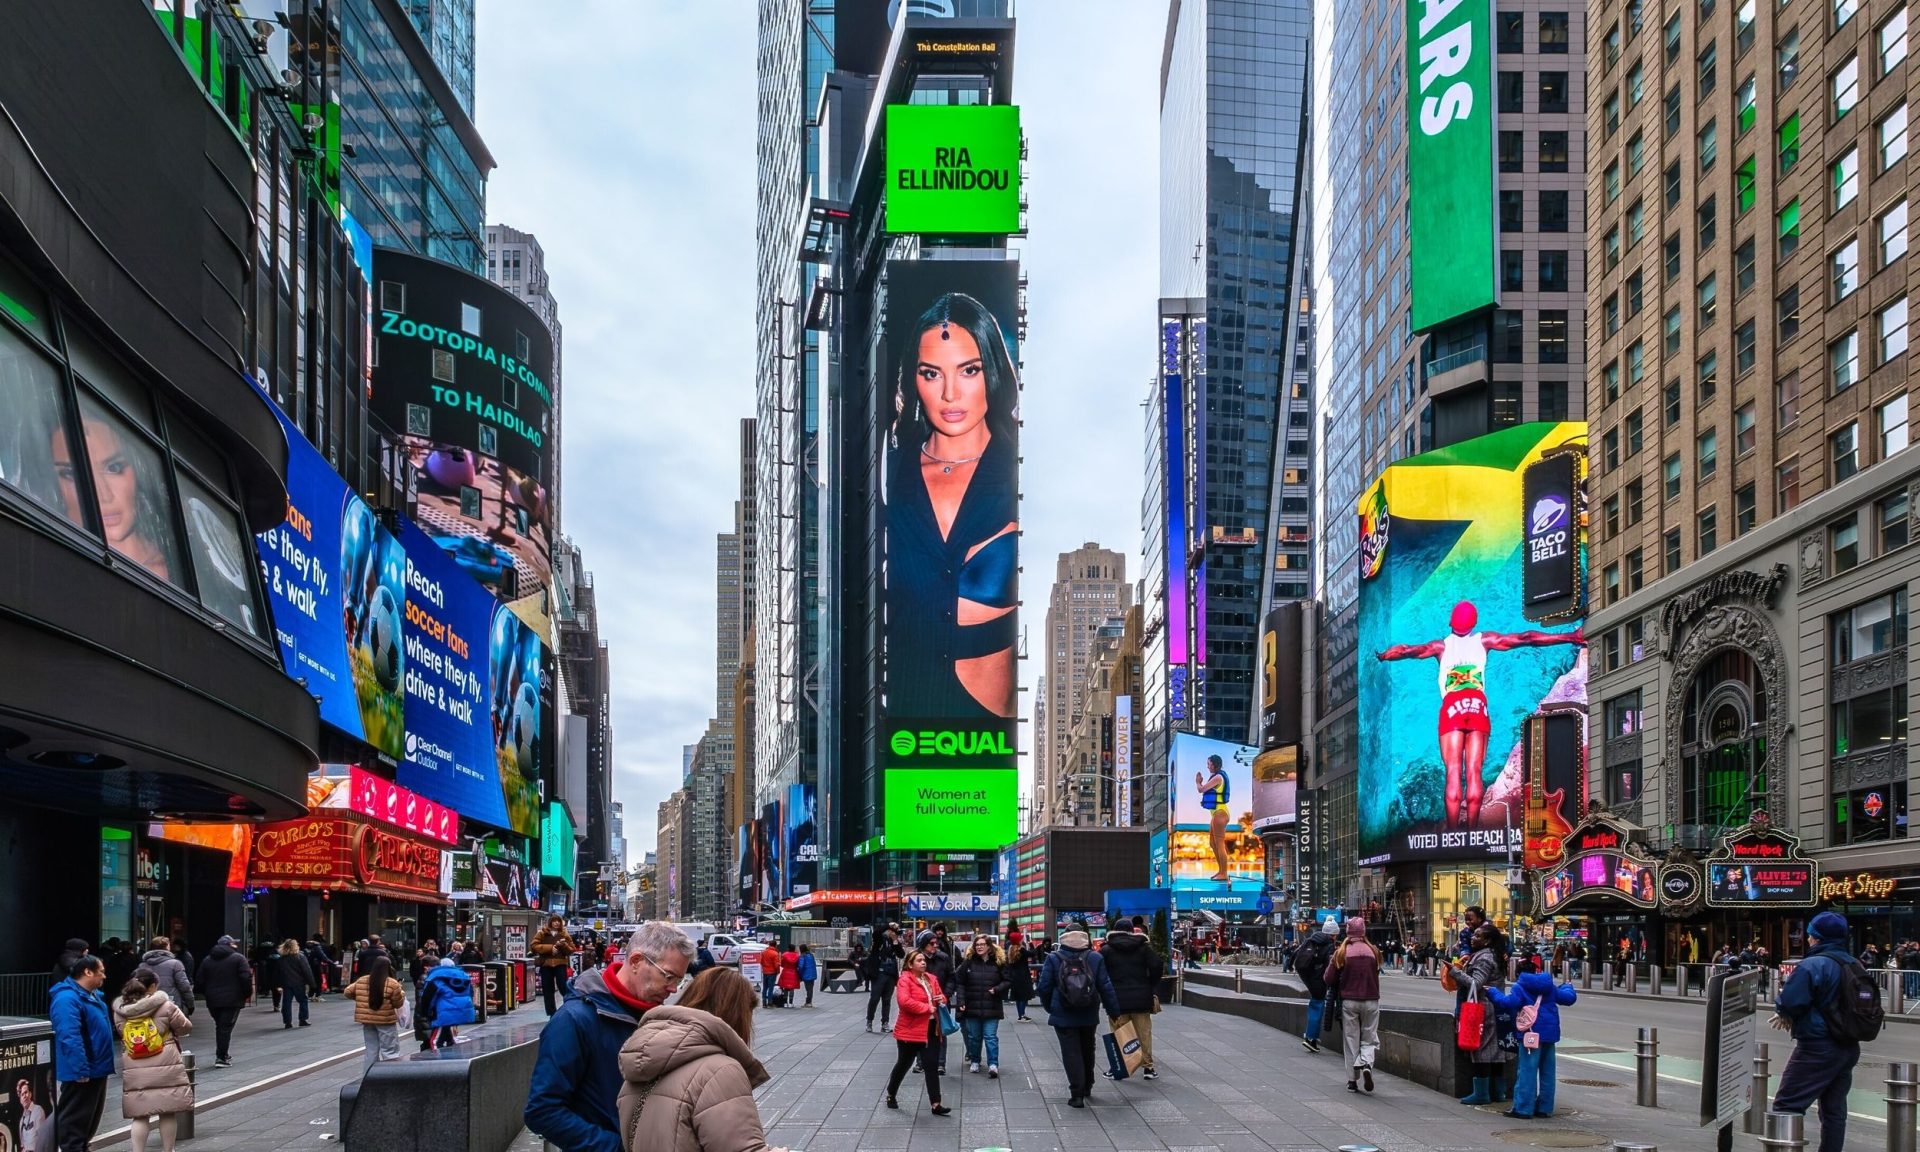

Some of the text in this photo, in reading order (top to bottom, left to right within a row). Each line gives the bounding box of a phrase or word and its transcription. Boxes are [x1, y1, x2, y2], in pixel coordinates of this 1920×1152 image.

[917, 43, 930, 51] The
[932, 43, 980, 52] Constellation
[935, 148, 972, 169] RIA
[898, 169, 1009, 191] ELLINIDOU
[501, 353, 516, 375] IS
[431, 384, 460, 407] TO
[1529, 530, 1566, 552] TACO
[281, 530, 309, 581] they
[312, 556, 329, 596] fly,
[1531, 543, 1566, 563] BELL
[272, 565, 283, 596] &
[286, 579, 317, 621] walk
[406, 558, 444, 609] Reach
[406, 599, 469, 660] soccer fans
[406, 634, 483, 703] where they fly,
[406, 668, 473, 726] drive & walk
[919, 731, 1014, 755] EQUAL
[1118, 716, 1128, 764] POWER
[917, 788, 986, 800] Women at
[916, 803, 990, 815] full volume.
[258, 822, 334, 857] CARLO'S
[1408, 834, 1438, 849] VOTED
[1441, 832, 1467, 847] BEST
[1470, 830, 1503, 846] BEACH
[1583, 832, 1618, 849] Hard Rock
[1734, 844, 1783, 857] Hard Rock
[352, 823, 423, 885] CARLO'S
[1301, 800, 1311, 905] TIMES SQUARE
[258, 861, 333, 875] BAKE SHOP
[1819, 873, 1895, 900] Rock Shop
[909, 896, 936, 911] NEW
[938, 896, 968, 911] YORK
[4, 1046, 19, 1056] ALL
[19, 1043, 36, 1053] TIME
